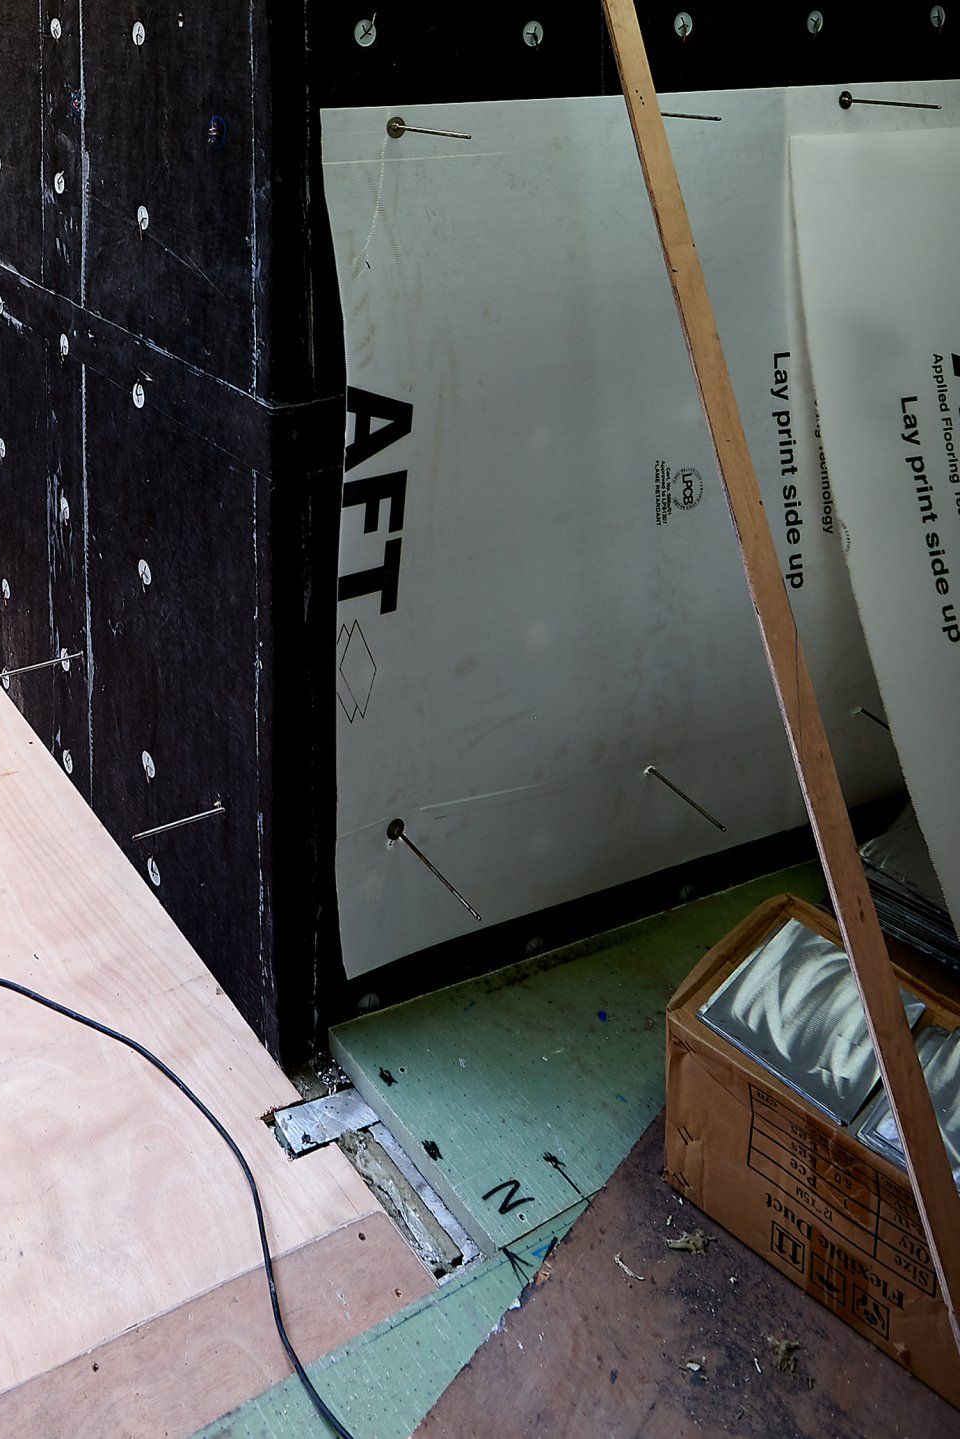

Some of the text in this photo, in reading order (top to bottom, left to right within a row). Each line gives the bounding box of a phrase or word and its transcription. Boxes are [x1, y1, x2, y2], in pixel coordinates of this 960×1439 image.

[933, 353, 960, 484] Applied Flooring
[338, 385, 414, 615] AFT
[682, 473, 694, 506] LPCB
[771, 351, 804, 590] Lay print side up
[900, 396, 960, 644] Lay print side up
[788, 1158, 818, 1190] Pce
[790, 1142, 817, 1170] kgs
[765, 1193, 905, 1310] Flexible Duct
[893, 1254, 929, 1287] Size
[898, 1237, 931, 1265] Qty
